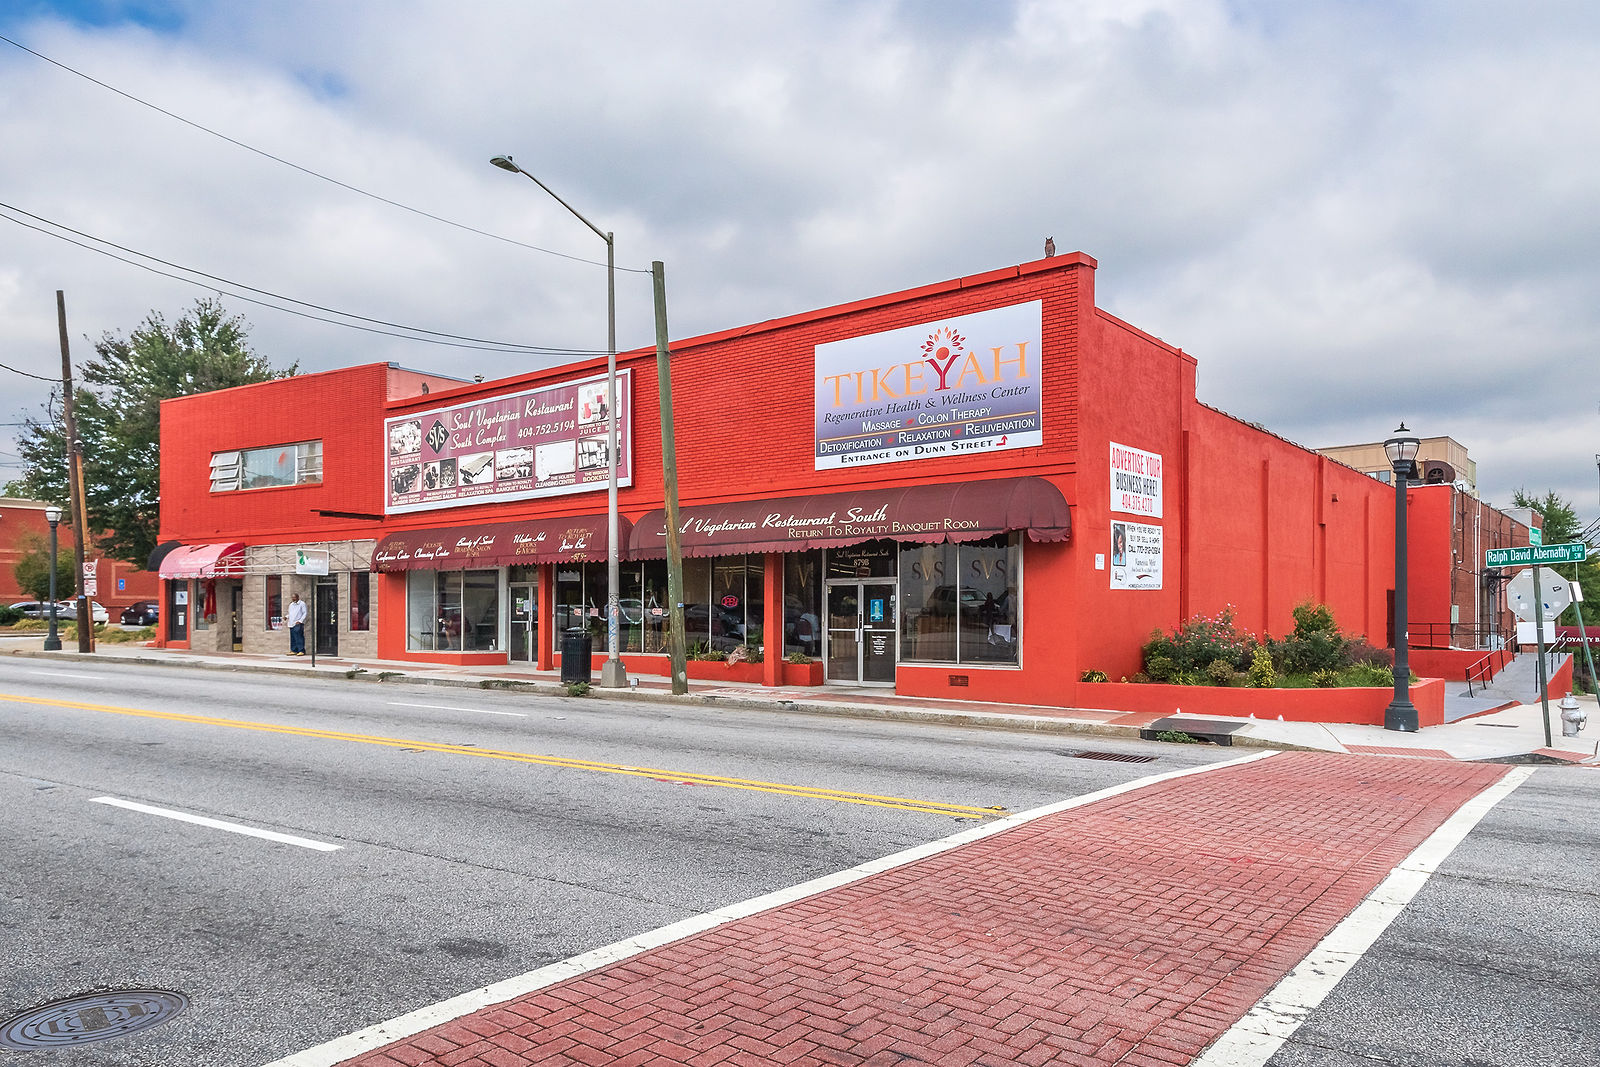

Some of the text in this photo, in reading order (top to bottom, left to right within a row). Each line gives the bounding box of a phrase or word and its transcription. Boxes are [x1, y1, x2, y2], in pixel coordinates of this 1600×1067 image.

[823, 341, 1030, 408] TIKEYAH
[451, 397, 574, 431] Soul Vegetarian Restaurant
[824, 385, 1030, 424] Regenerative Health & Wellness Center
[518, 419, 575, 439] 404.752.5194
[579, 427, 602, 435] JUICE
[862, 407, 992, 432] MASSAGE COLON THERAPY
[429, 425, 445, 450] SVS
[450, 426, 507, 449] South Complex
[820, 418, 1035, 453] DETOXIFICATION RELAXATION REJUVENATION
[841, 451, 891, 463] ENTRANCE
[914, 445, 946, 455] DUNN
[951, 440, 993, 451] STREET
[1112, 447, 1161, 478] ADVERTISE YOUR
[496, 485, 519, 493] BANQUET
[583, 474, 609, 483] BOOKSTO
[1116, 471, 1158, 497] BUSINESS HERE!
[695, 518, 757, 536] Vegetarian
[761, 512, 837, 528] Restaurant
[838, 503, 889, 523] South
[788, 518, 979, 538] RETURN TO ROYALTY BANQUET ROOM
[1487, 545, 1583, 564] Ralph David Abernathy BLVD
[911, 557, 944, 581] SVS
[971, 557, 1006, 580] SVS
